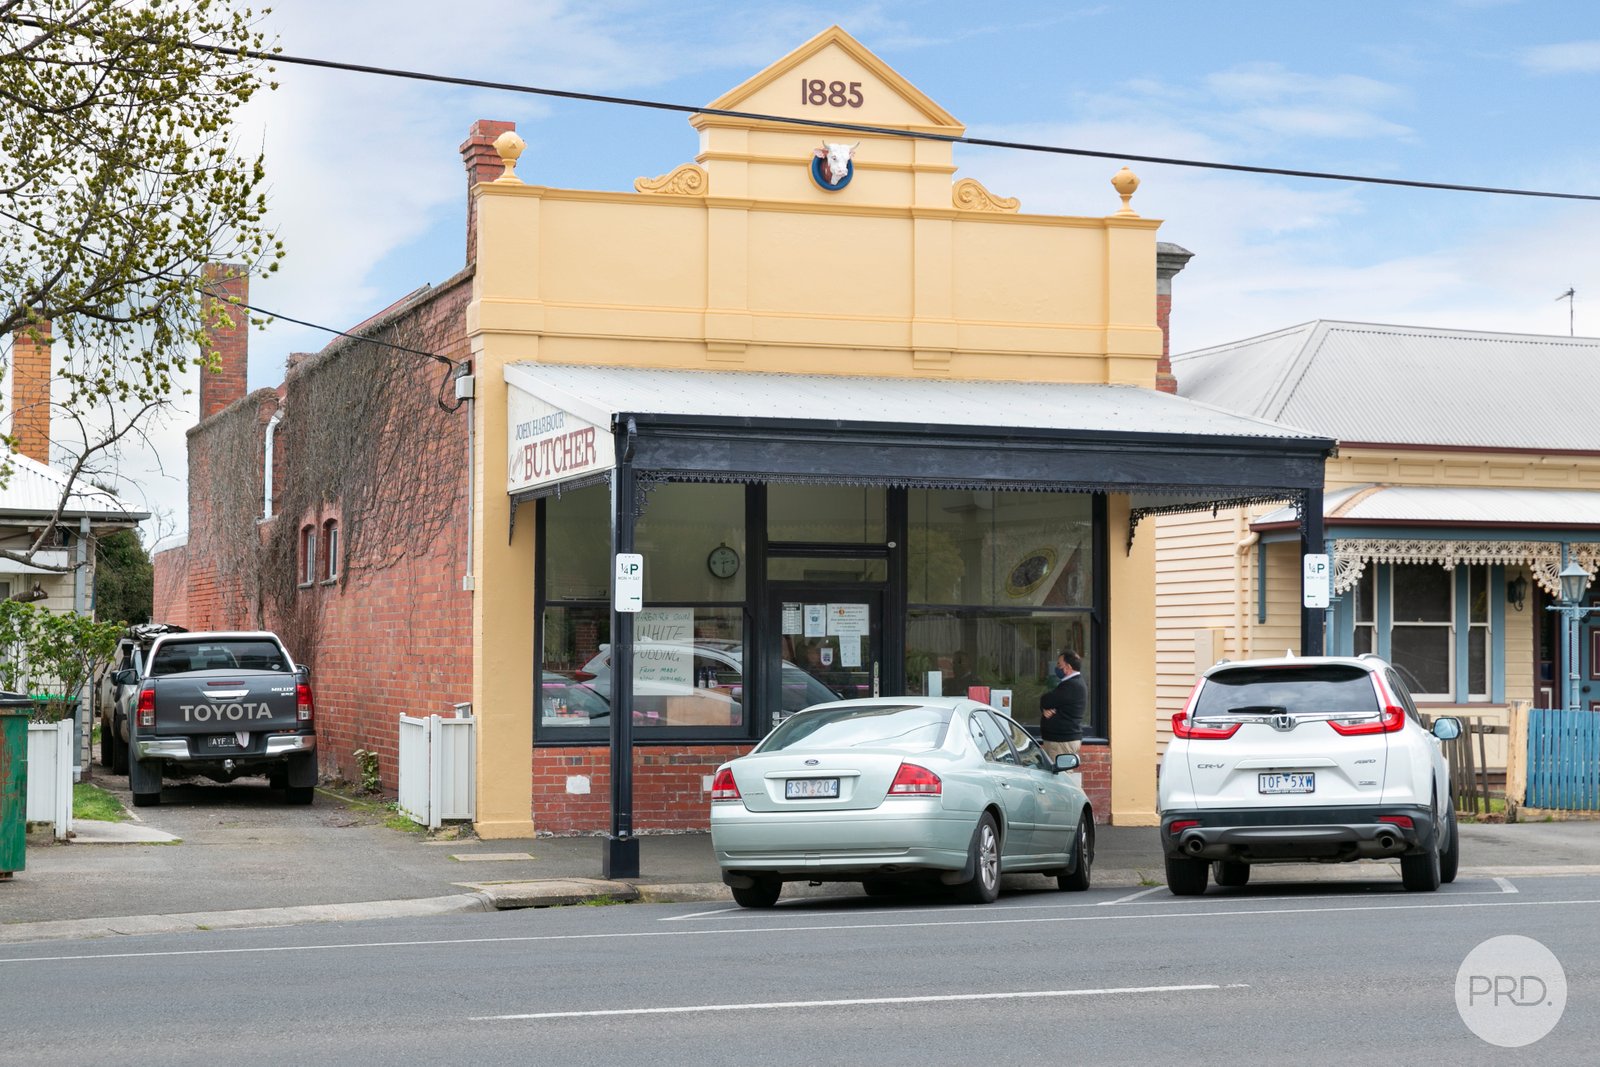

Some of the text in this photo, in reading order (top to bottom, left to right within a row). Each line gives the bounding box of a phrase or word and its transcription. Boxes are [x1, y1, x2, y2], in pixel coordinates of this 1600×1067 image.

[801, 78, 864, 109] 1885
[516, 411, 564, 441] JOHN HARBOUR
[524, 426, 597, 481] BUTCHER
[636, 623, 687, 641] WHITE
[180, 702, 273, 722] TOYOTA
